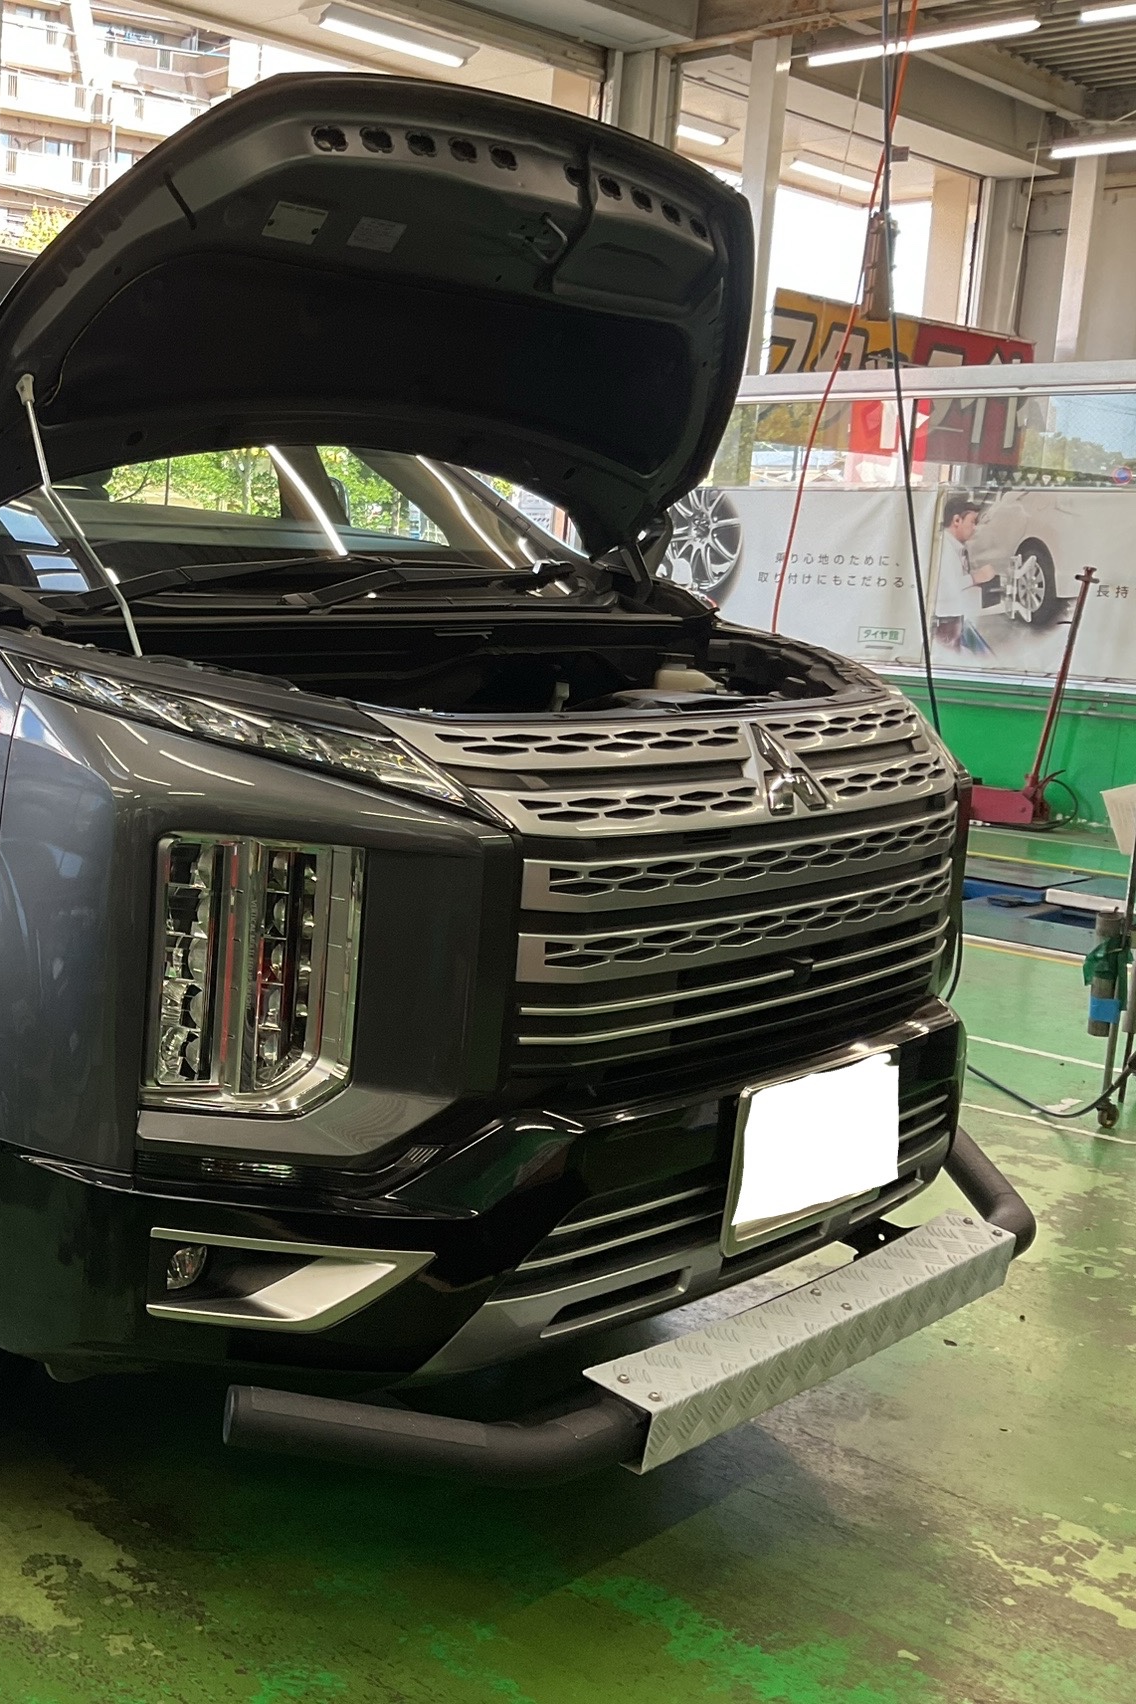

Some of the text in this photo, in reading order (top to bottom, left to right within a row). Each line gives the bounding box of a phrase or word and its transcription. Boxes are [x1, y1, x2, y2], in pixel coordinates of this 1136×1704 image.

[757, 571, 915, 589] 取り付けにもこだわる。
[863, 629, 899, 641] タイヤ館
